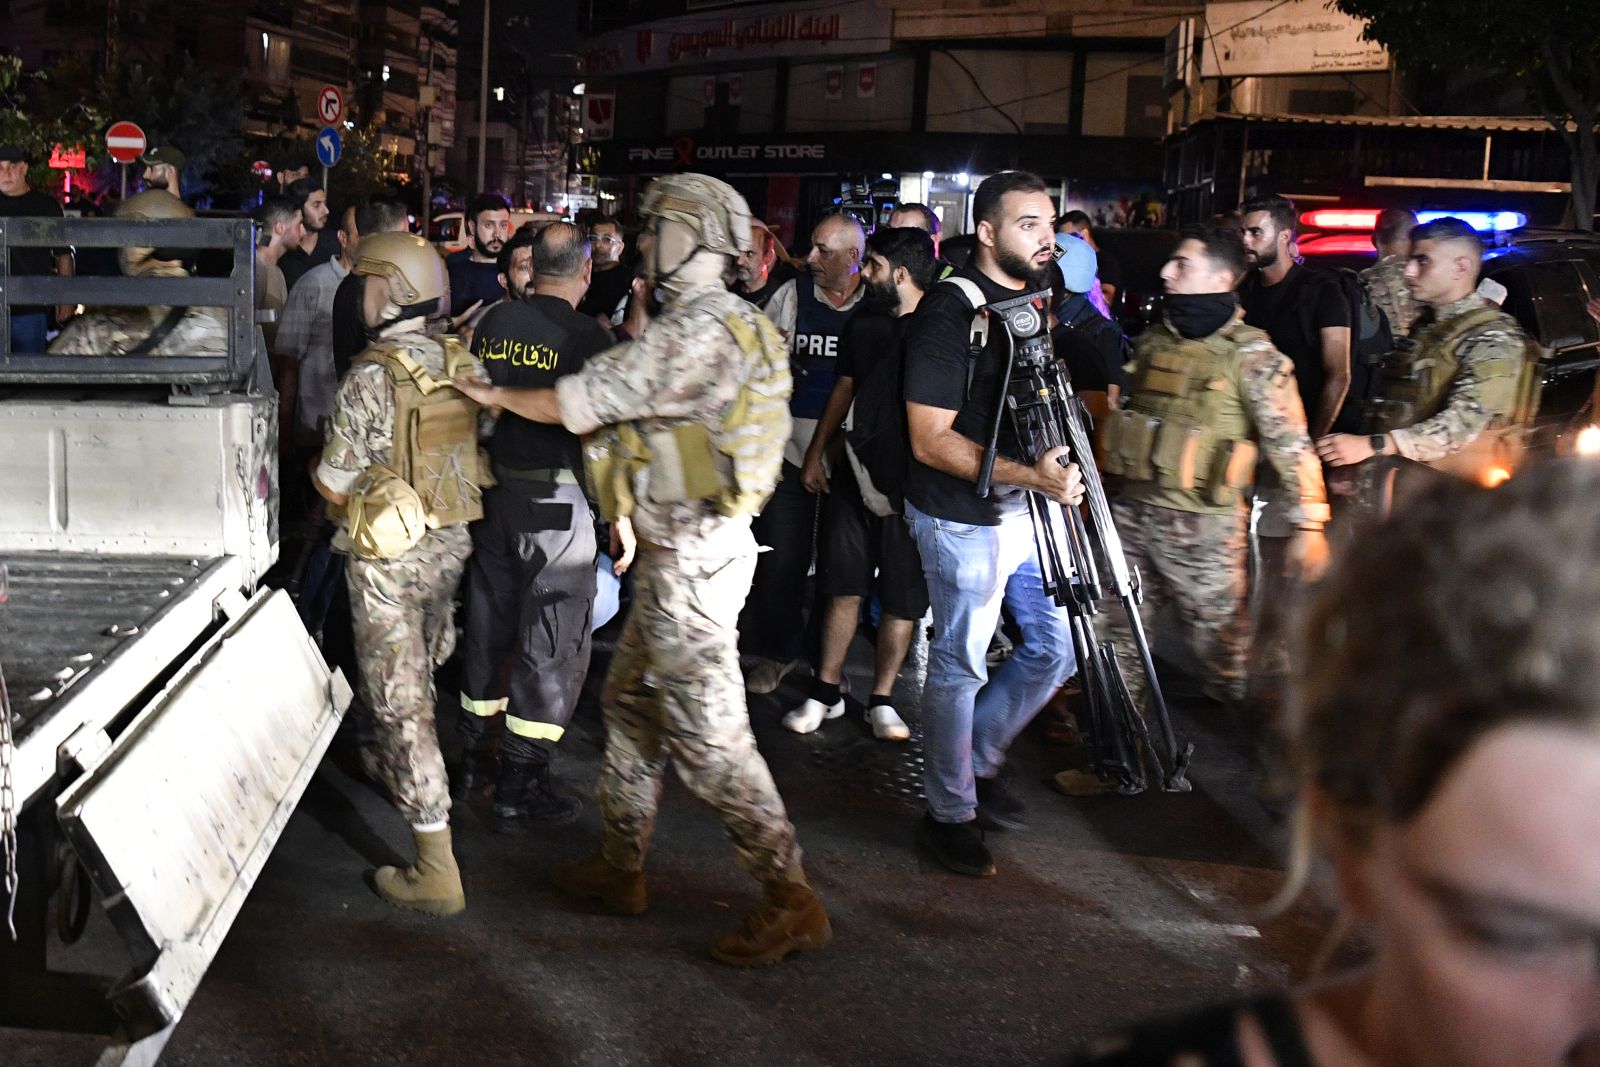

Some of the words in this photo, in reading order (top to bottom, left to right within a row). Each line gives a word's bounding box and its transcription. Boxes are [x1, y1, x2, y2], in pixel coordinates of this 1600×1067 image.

[799, 13, 840, 46] البنك
[628, 146, 674, 160] FINE
[695, 145, 760, 159] OUTLET
[763, 144, 825, 159] STORE
